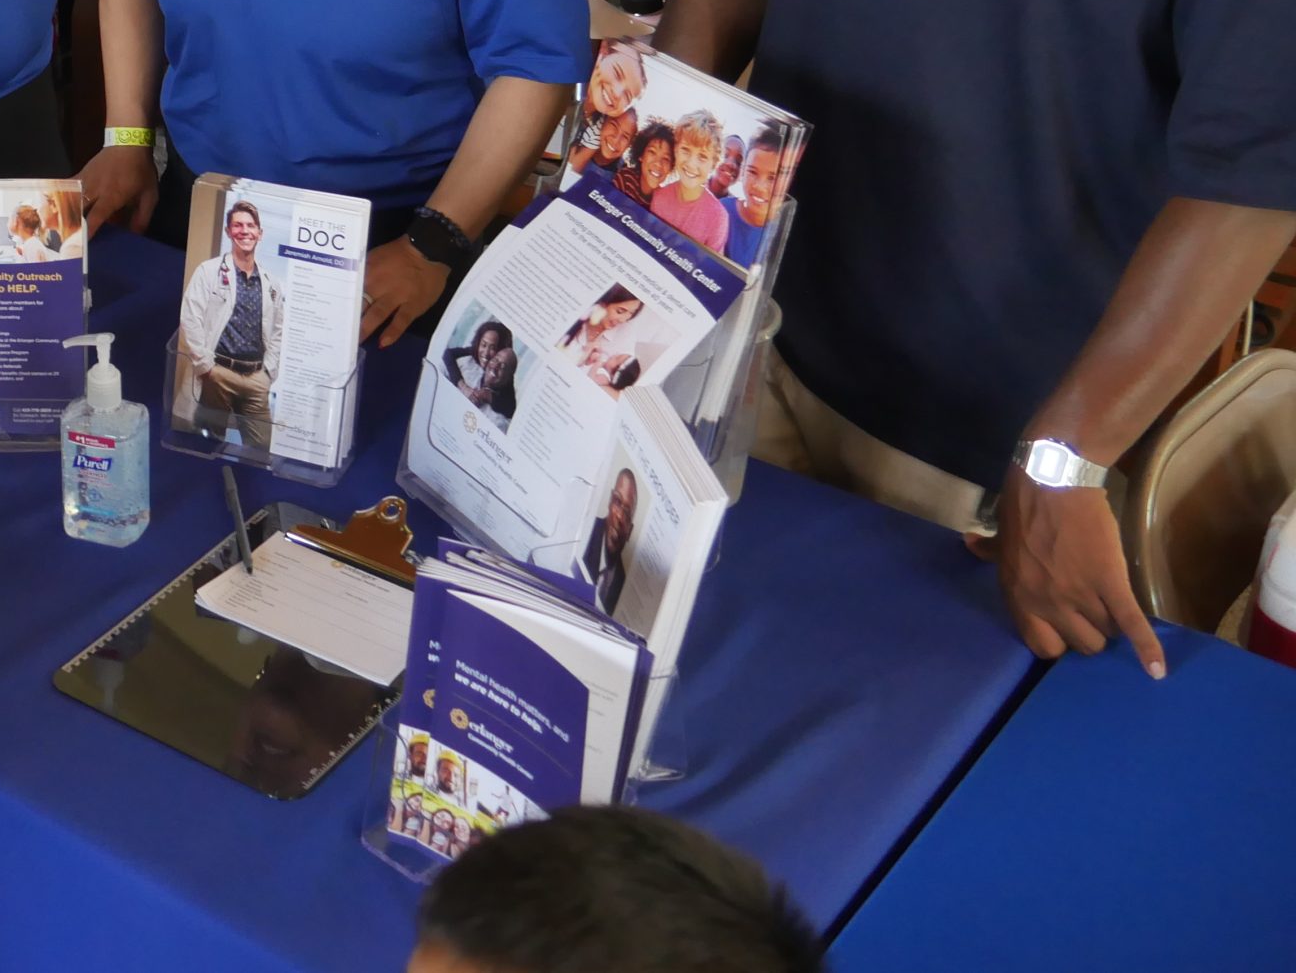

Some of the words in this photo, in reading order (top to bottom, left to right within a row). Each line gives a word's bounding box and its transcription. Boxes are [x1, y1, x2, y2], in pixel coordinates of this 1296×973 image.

[298, 226, 346, 251] DOC
[588, 189, 621, 218] Erlanger
[620, 213, 667, 253] Community
[664, 246, 694, 272] Health
[692, 269, 722, 294] Center
[7, 284, 40, 293] HELP.
[16, 272, 62, 281] Outreach
[77, 455, 109, 471] Purell
[454, 672, 470, 686] we
[470, 682, 488, 696] are
[488, 689, 510, 710] here
[510, 703, 521, 718] to
[456, 659, 488, 684] Mental
[489, 677, 517, 702] health
[552, 724, 570, 743] and
